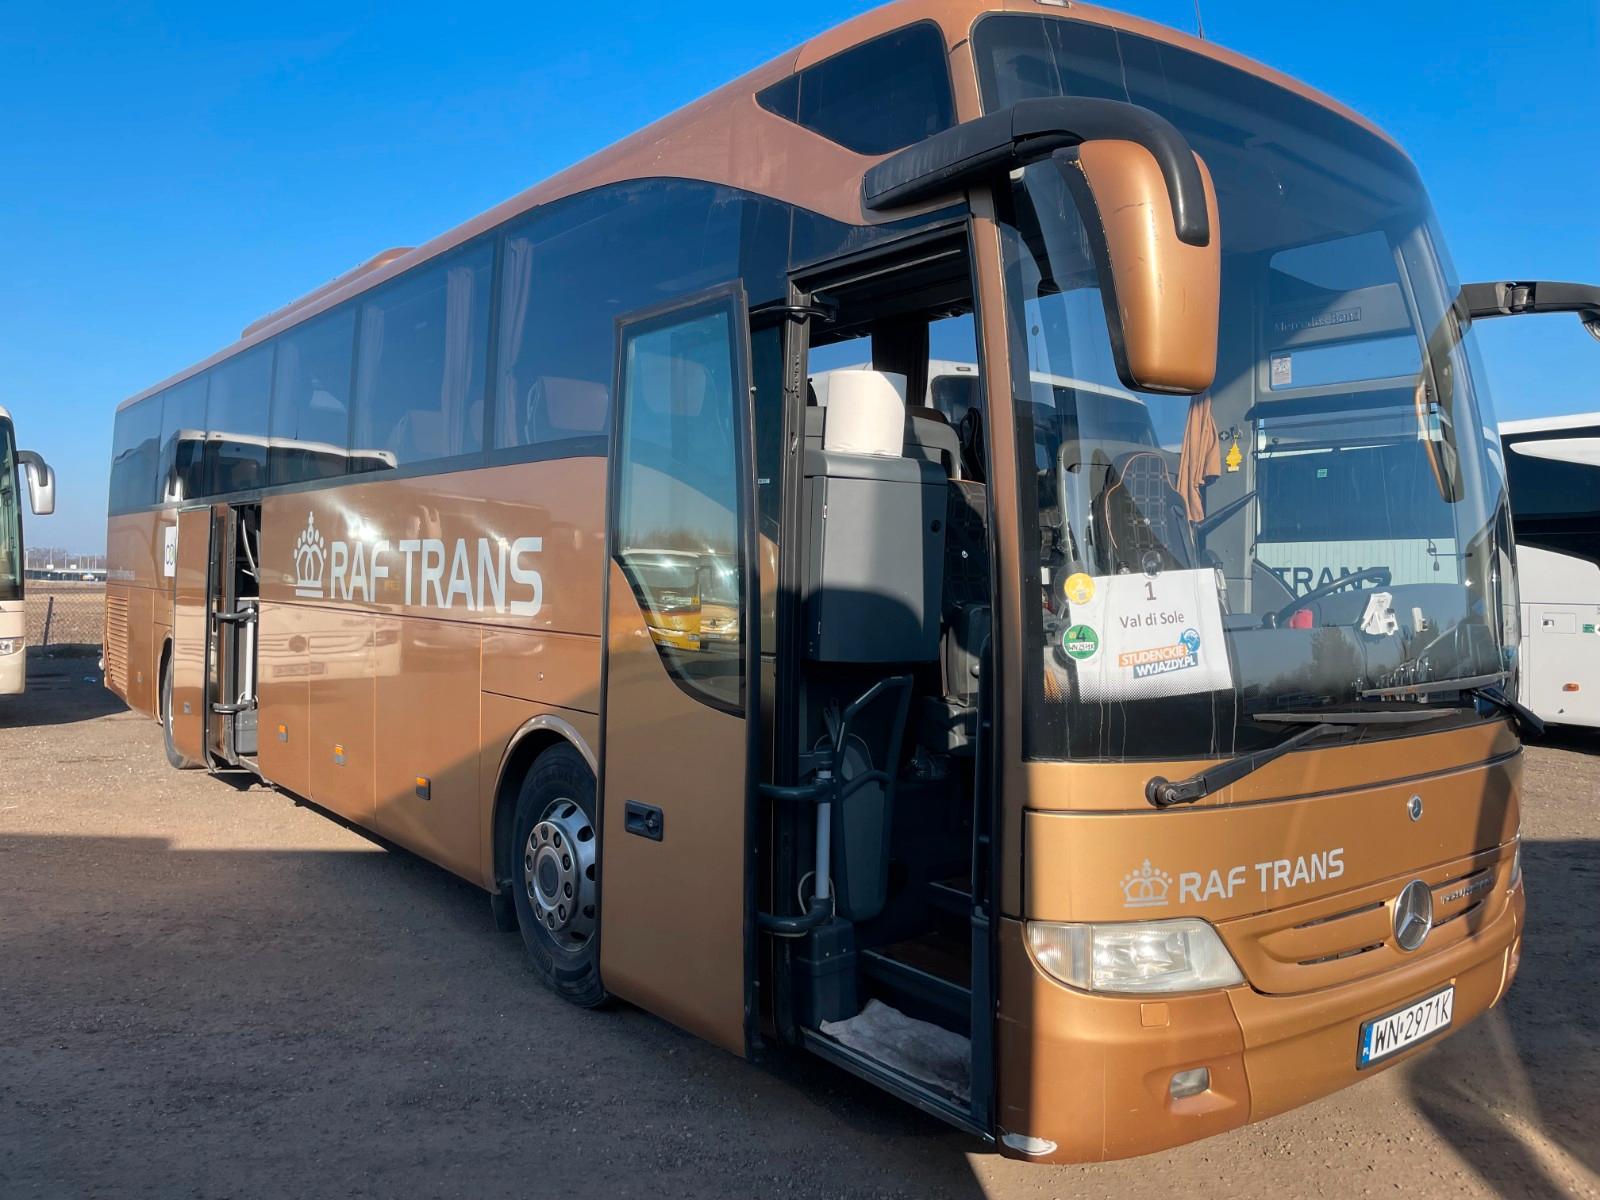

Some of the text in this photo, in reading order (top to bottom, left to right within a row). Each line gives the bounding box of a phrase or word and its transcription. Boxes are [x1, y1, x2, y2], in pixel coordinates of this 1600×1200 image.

[330, 536, 543, 617] RAF TRANS
[1144, 580, 1157, 601] 1
[1119, 610, 1185, 629] Val di Sole
[1075, 625, 1087, 642] 4
[1121, 645, 1185, 667] STUDENCKIE
[1135, 655, 1196, 677] WYJAZDY.PL
[1179, 848, 1345, 904] RAF TRANS
[1374, 991, 1452, 1055] WN 2971K
